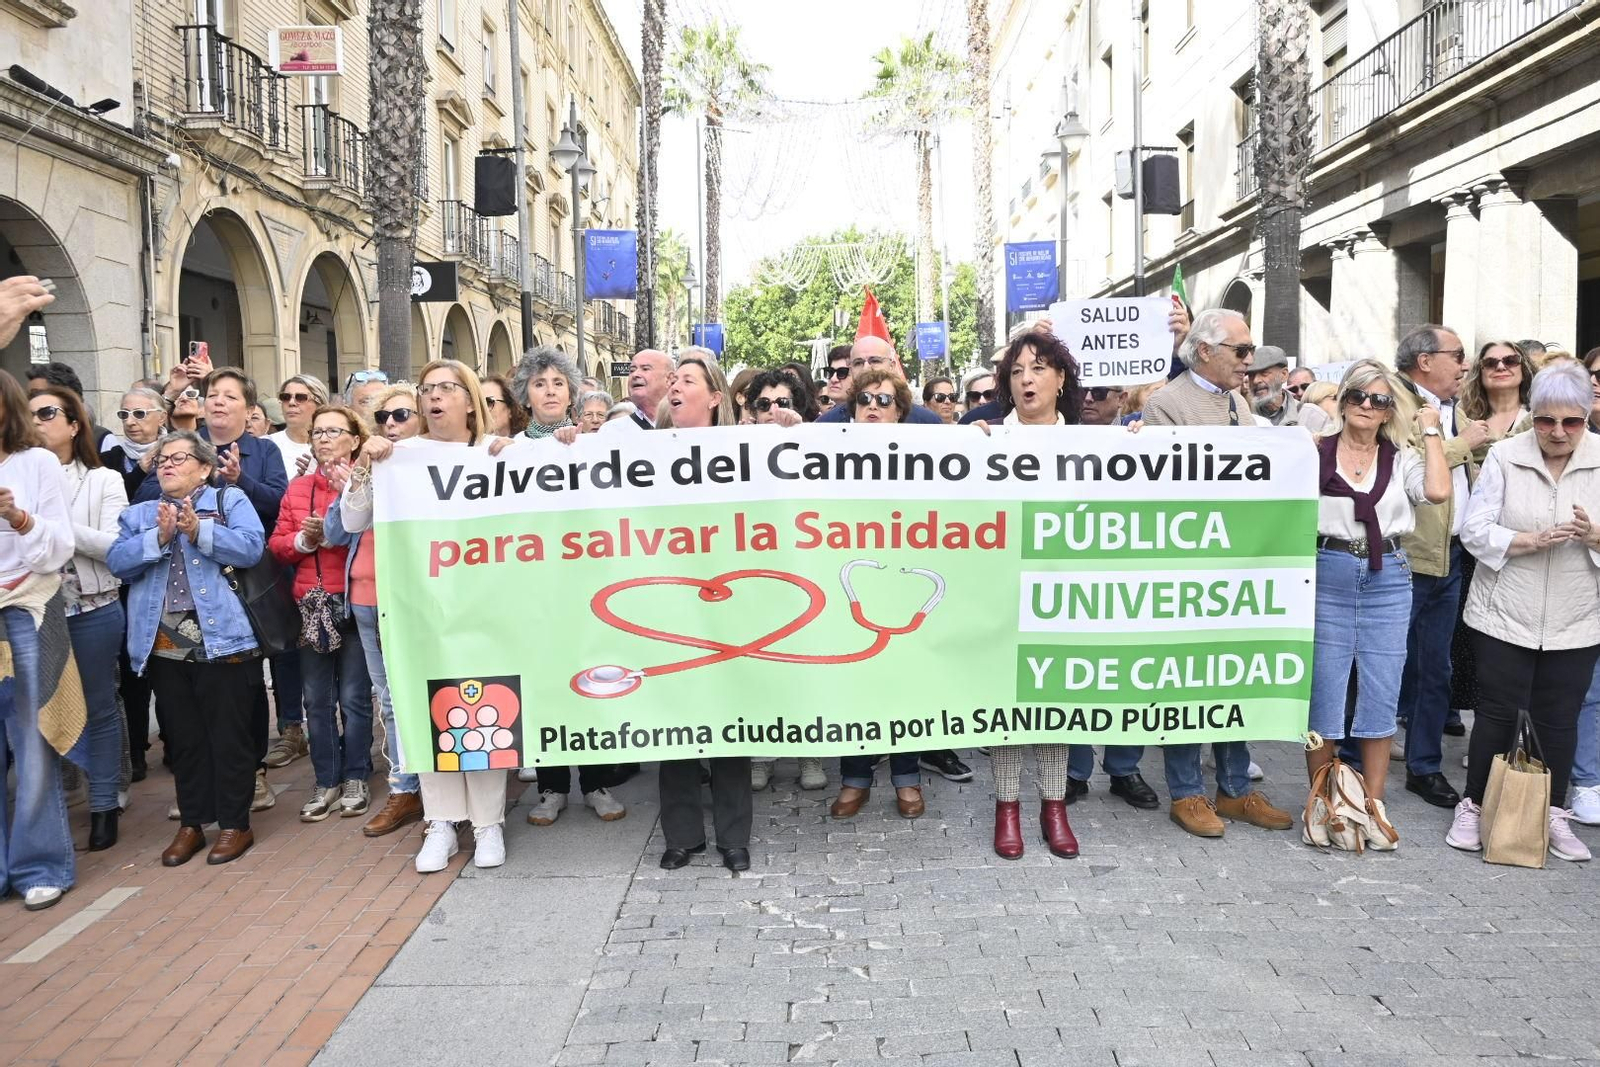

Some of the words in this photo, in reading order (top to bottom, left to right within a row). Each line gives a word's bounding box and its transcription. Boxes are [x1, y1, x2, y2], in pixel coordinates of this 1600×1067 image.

[1080, 306, 1140, 324] SALUD
[1081, 333, 1140, 351] ANTES
[1099, 357, 1166, 377] DINERO
[427, 449, 656, 501] Valverde
[670, 442, 751, 486] del
[766, 442, 971, 481] Camino
[986, 453, 1041, 482] se
[1056, 443, 1271, 482] moviliza
[428, 533, 545, 578] para
[561, 517, 719, 560] salvar
[734, 512, 778, 552] la
[794, 511, 1006, 550] Sanidad
[1033, 503, 1232, 551] PÚBLICA
[1031, 579, 1287, 620] UNIVERSAL
[1026, 656, 1054, 690] Y
[1065, 657, 1120, 691] DE
[1130, 652, 1306, 691] CALIDAD
[540, 721, 713, 753] Plataforma
[721, 716, 882, 744] ciudadana
[889, 717, 935, 746] por
[941, 709, 965, 736] la
[972, 707, 1113, 734] SANIDAD
[1121, 702, 1245, 732] PÚBLICA
